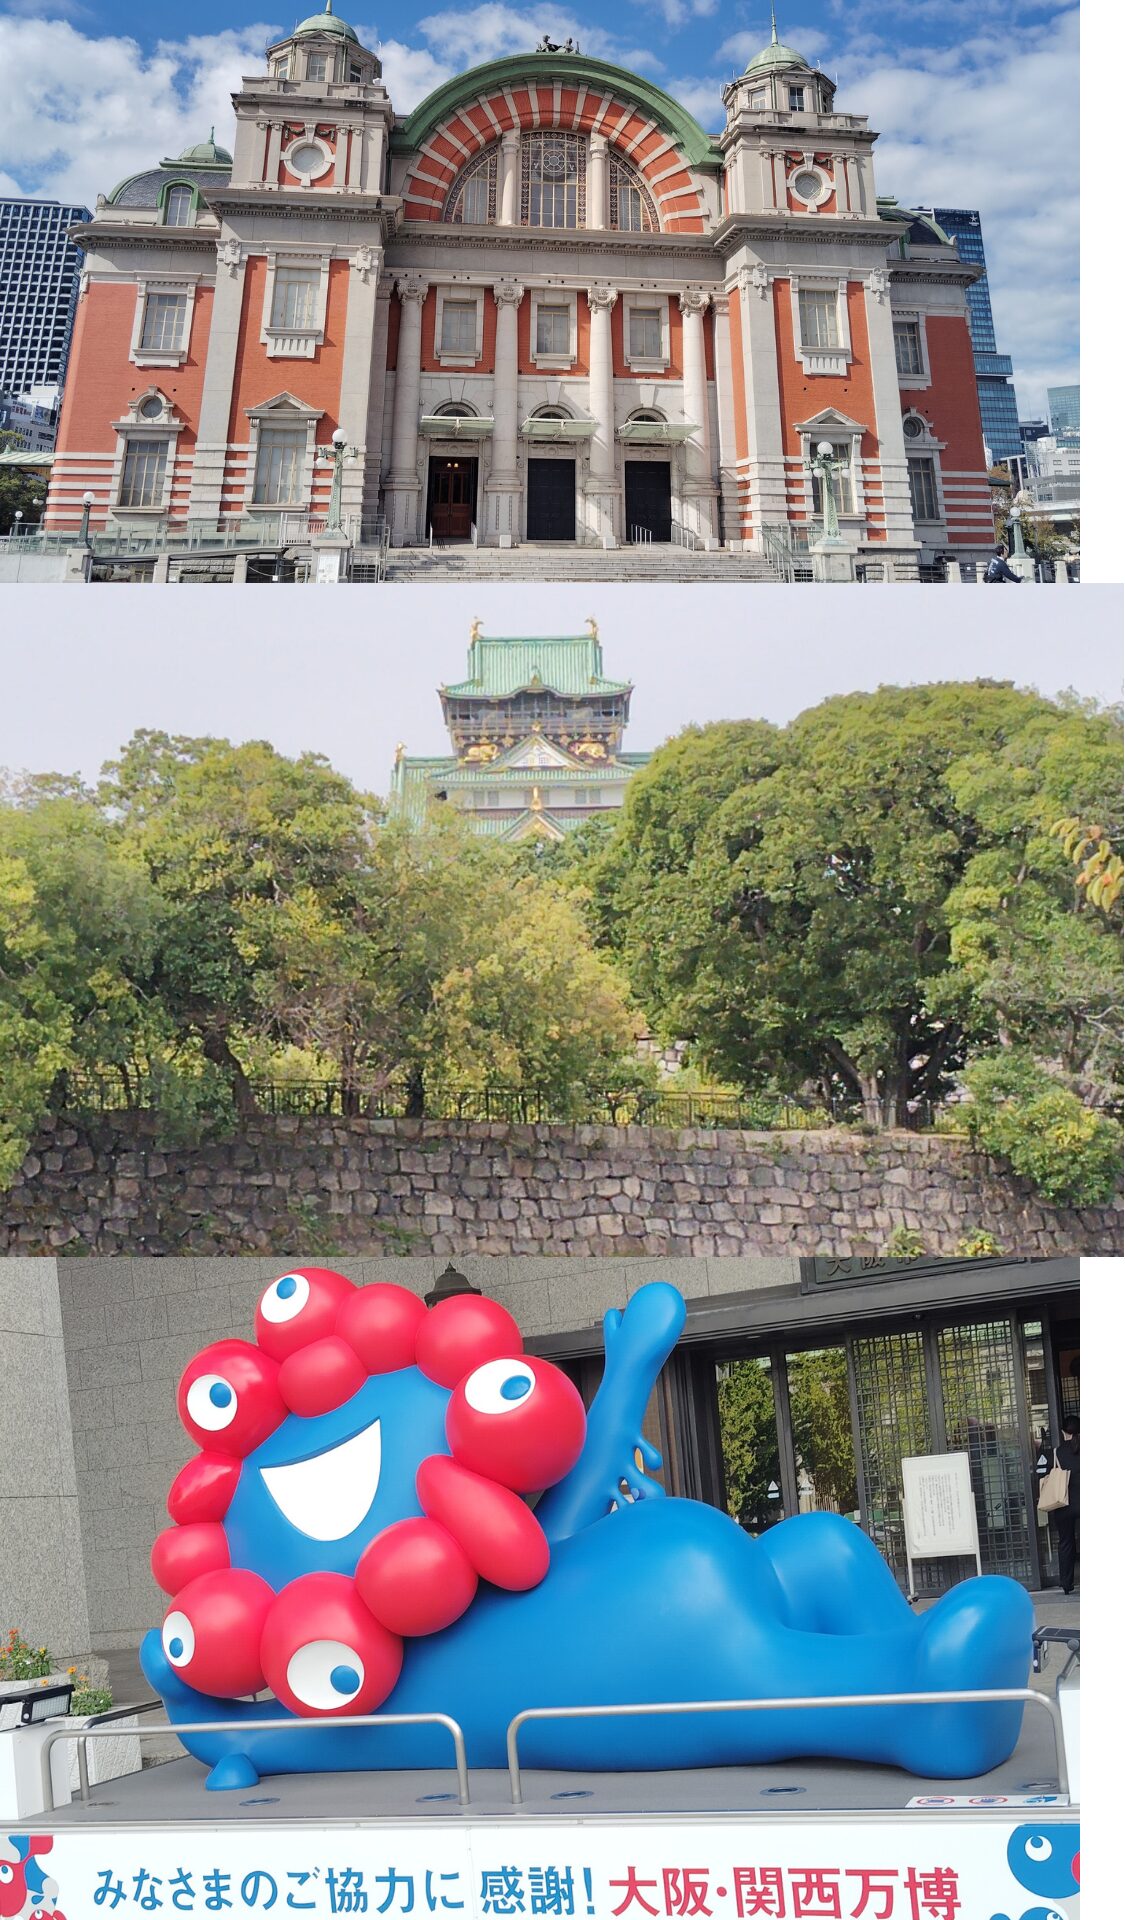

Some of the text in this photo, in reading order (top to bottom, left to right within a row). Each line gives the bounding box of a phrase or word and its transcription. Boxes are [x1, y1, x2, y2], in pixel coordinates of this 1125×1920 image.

[94, 1867, 465, 1914] みなさまのご協力に
[609, 1866, 961, 1920] 大阪・関西万博
